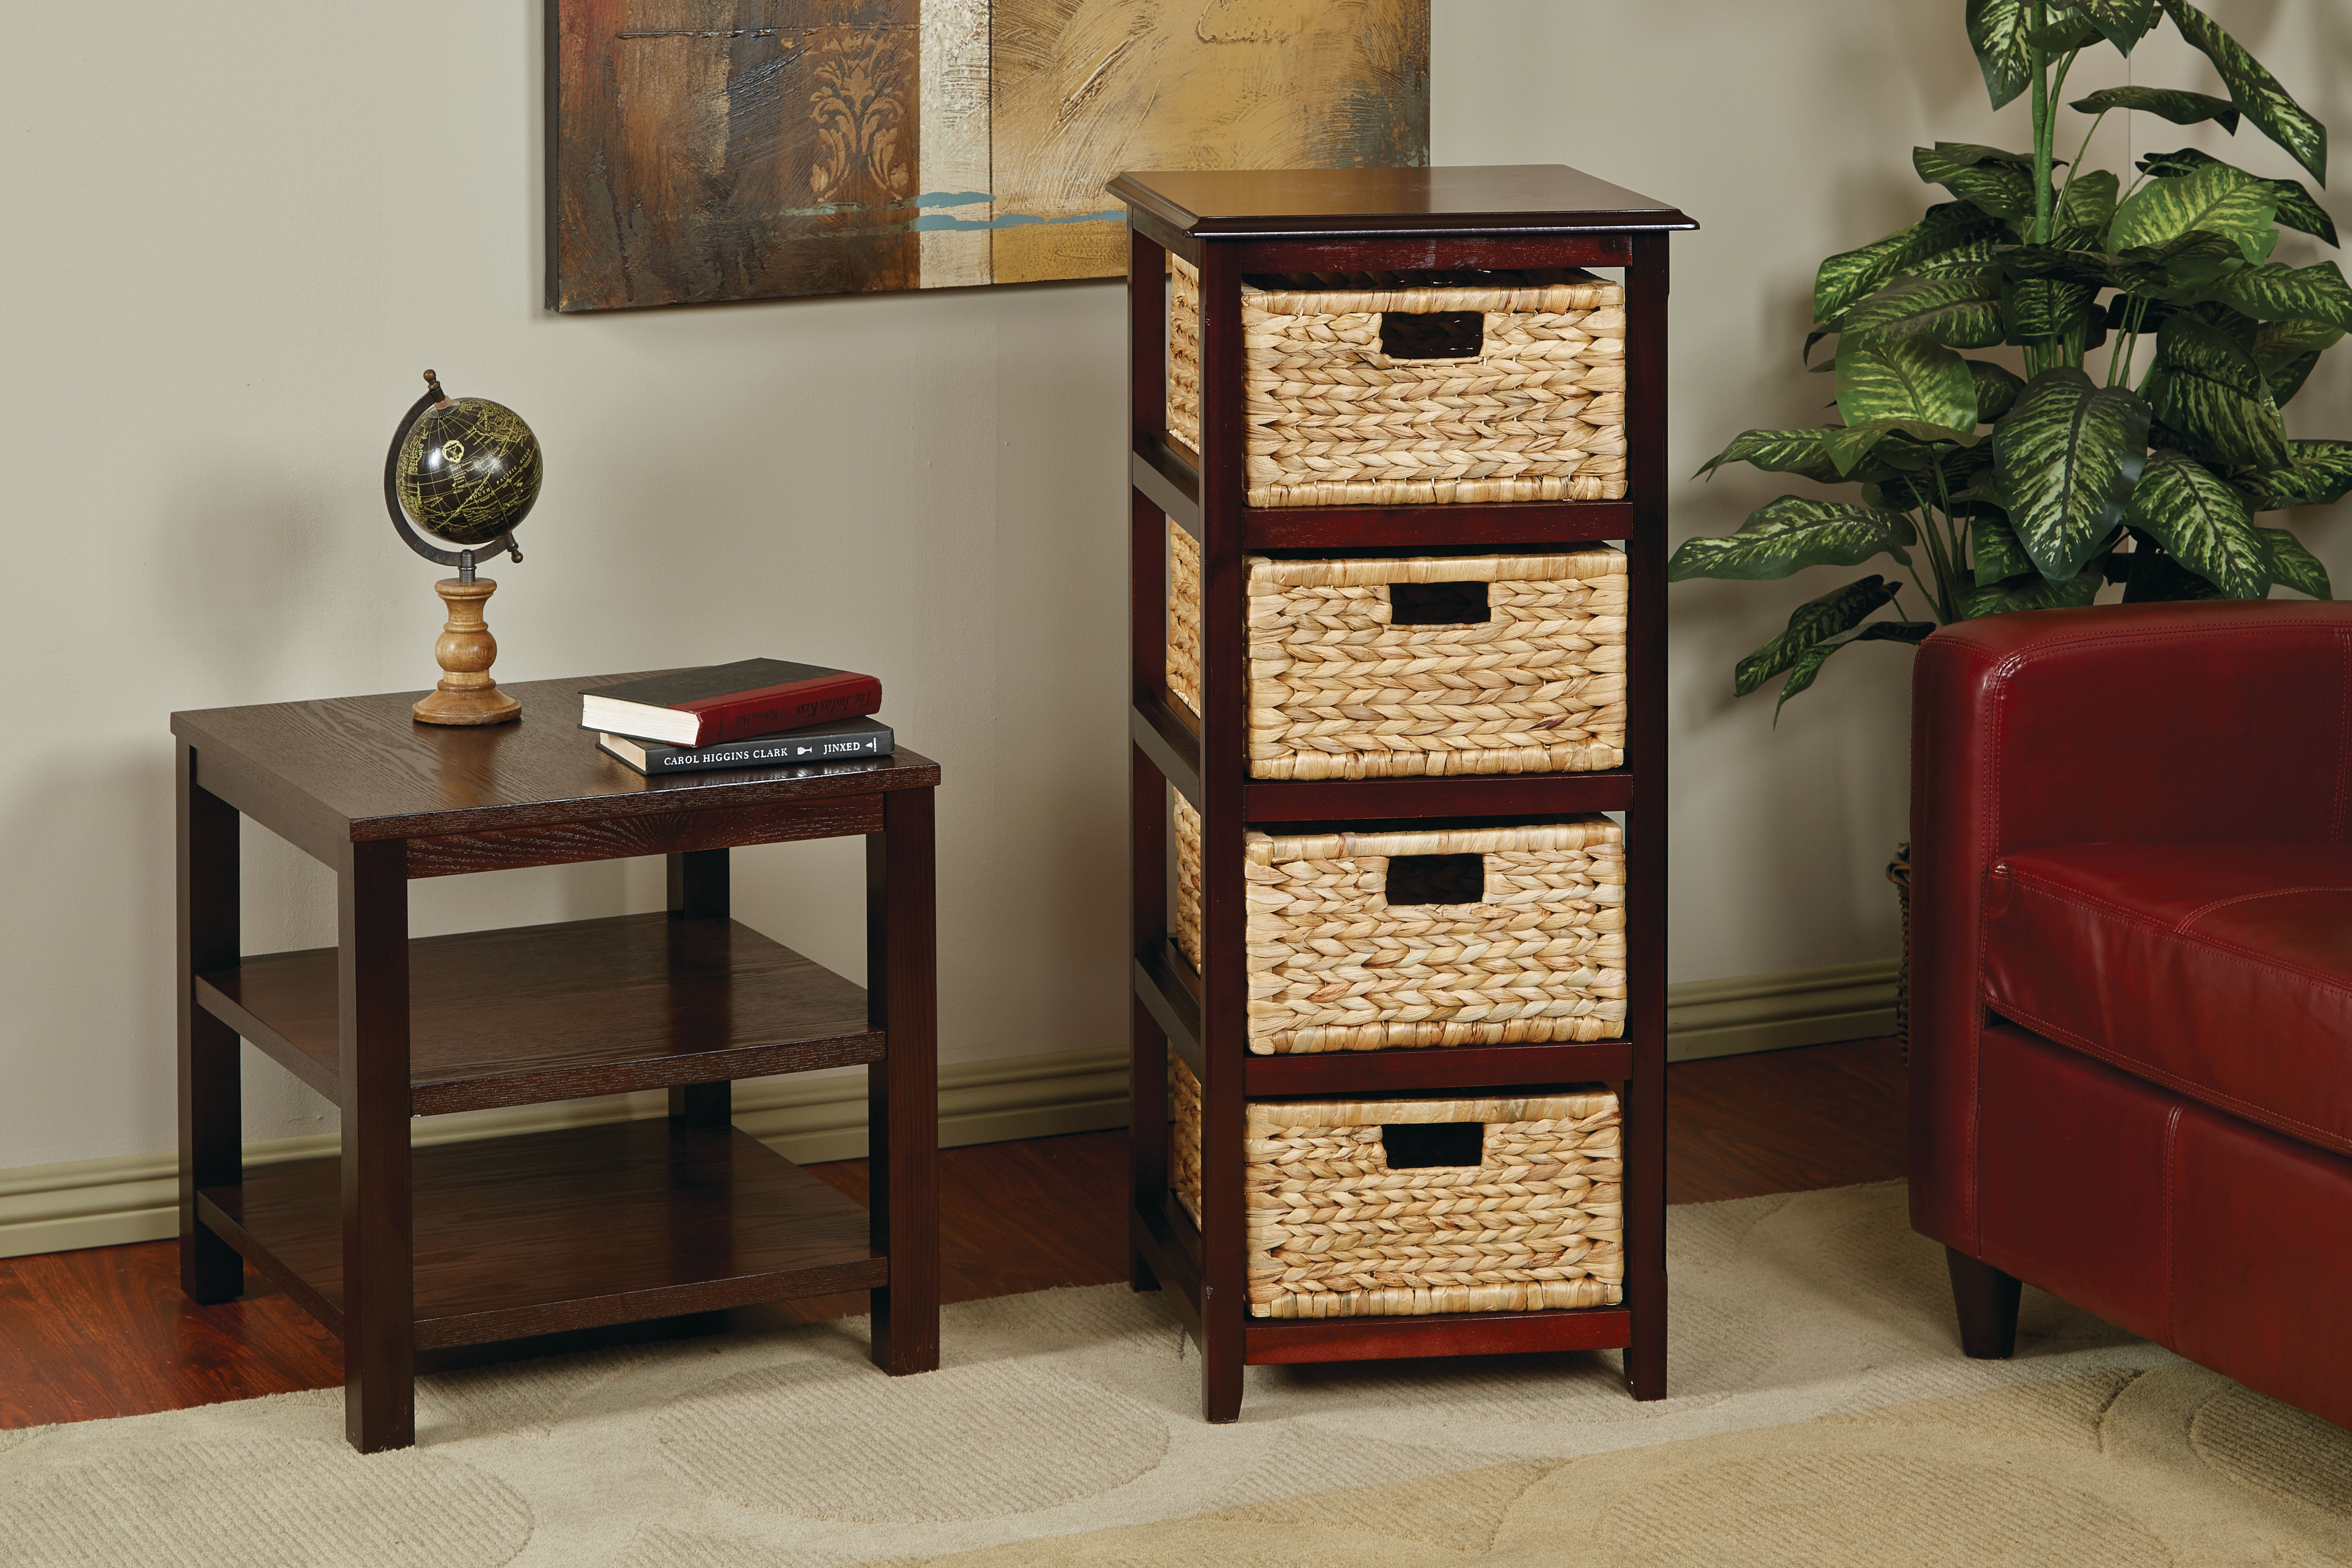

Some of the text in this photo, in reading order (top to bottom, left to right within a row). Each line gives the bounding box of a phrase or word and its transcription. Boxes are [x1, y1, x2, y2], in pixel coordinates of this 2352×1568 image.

[496, 465, 517, 484] PACIFIC
[797, 692, 872, 717] The Judas Kiss
[735, 709, 777, 725] Victoria Holt
[664, 748, 788, 765] CAROL HIGGINS CLARK
[823, 742, 860, 755] JINXED
